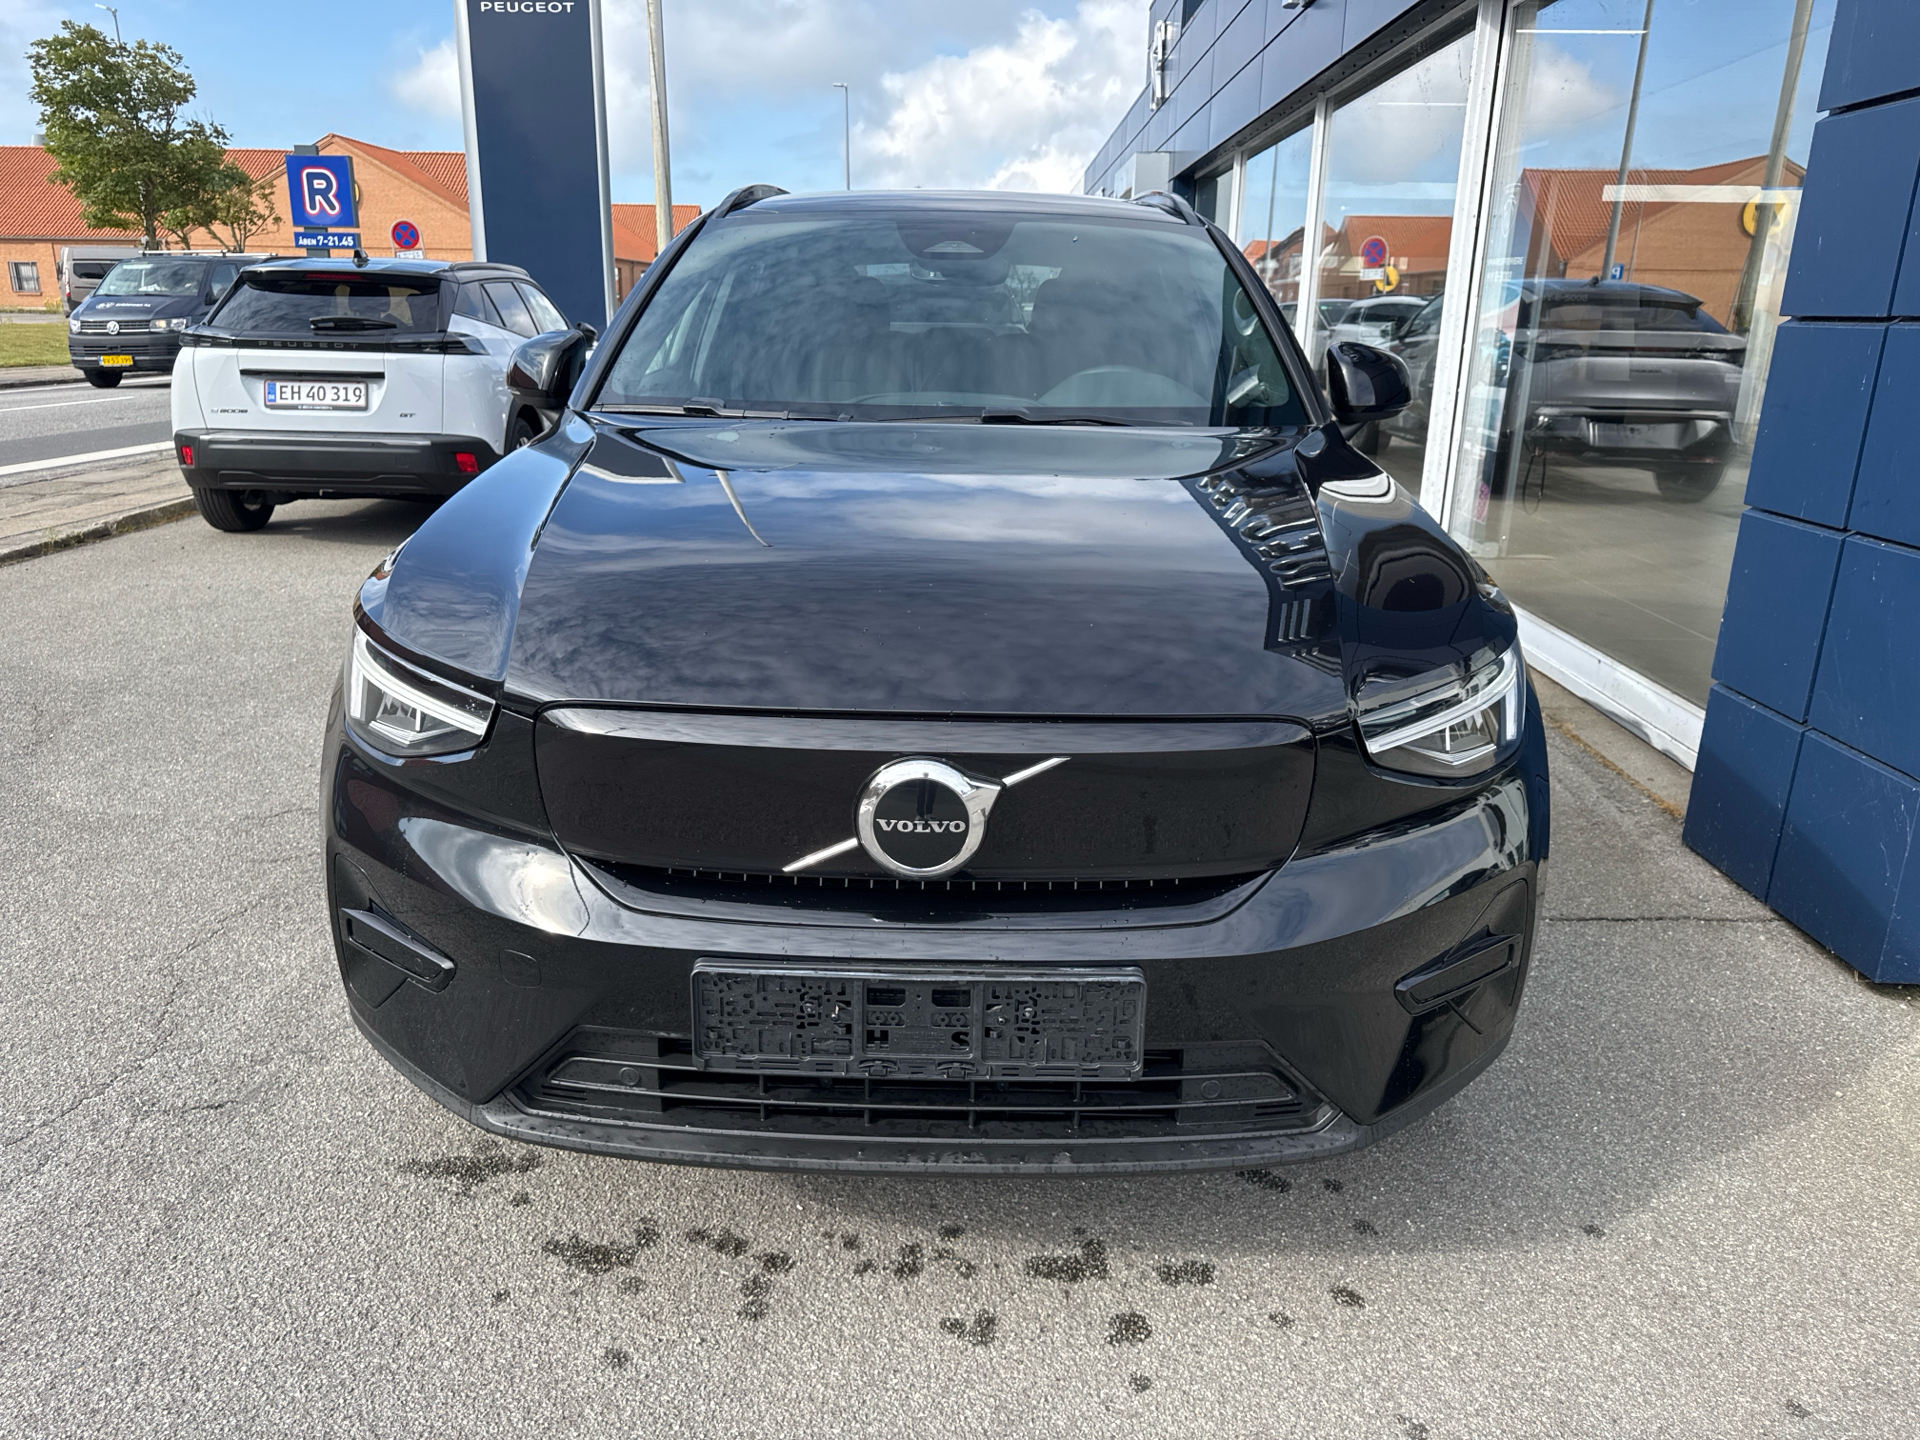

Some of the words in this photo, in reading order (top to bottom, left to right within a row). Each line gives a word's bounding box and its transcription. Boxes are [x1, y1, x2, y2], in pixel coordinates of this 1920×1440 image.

[480, 1, 575, 13] PEUGEOT
[317, 235, 354, 247] 7-21.45
[258, 340, 359, 349] PEUGEOT
[279, 385, 301, 400] EH
[306, 385, 326, 401] 40
[331, 386, 362, 402] 319
[876, 818, 966, 833] VOLVO
